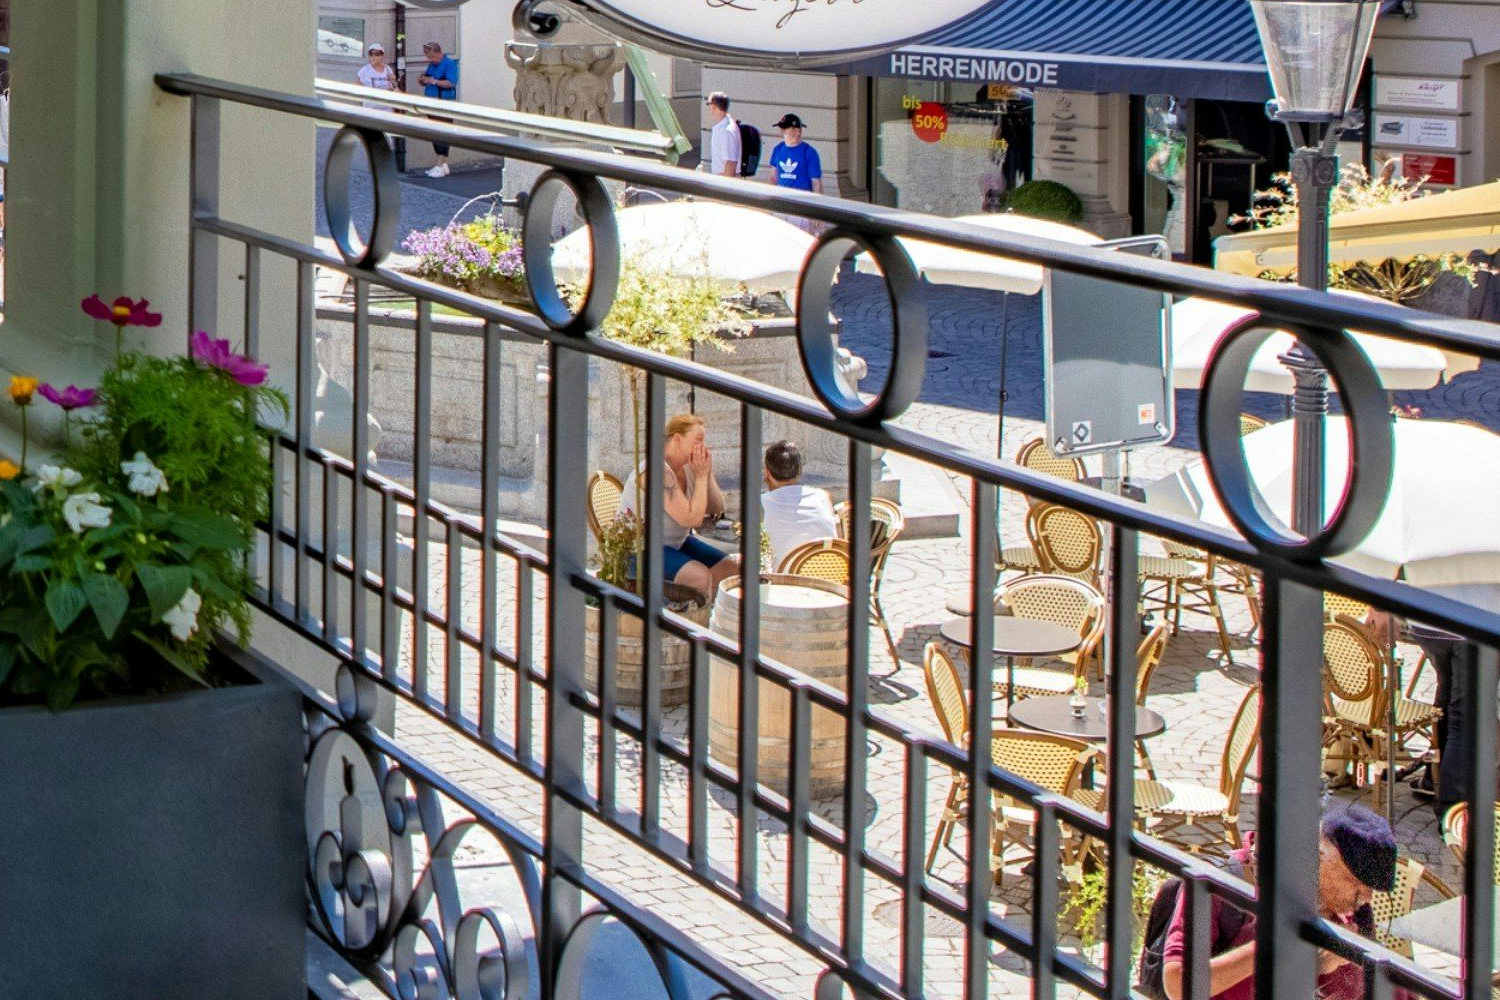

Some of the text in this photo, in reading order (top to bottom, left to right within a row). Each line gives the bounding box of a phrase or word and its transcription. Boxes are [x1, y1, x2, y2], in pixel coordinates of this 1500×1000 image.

[890, 53, 1059, 85] HERRENMODE
[902, 94, 923, 110] bis
[915, 114, 945, 130] 50%
